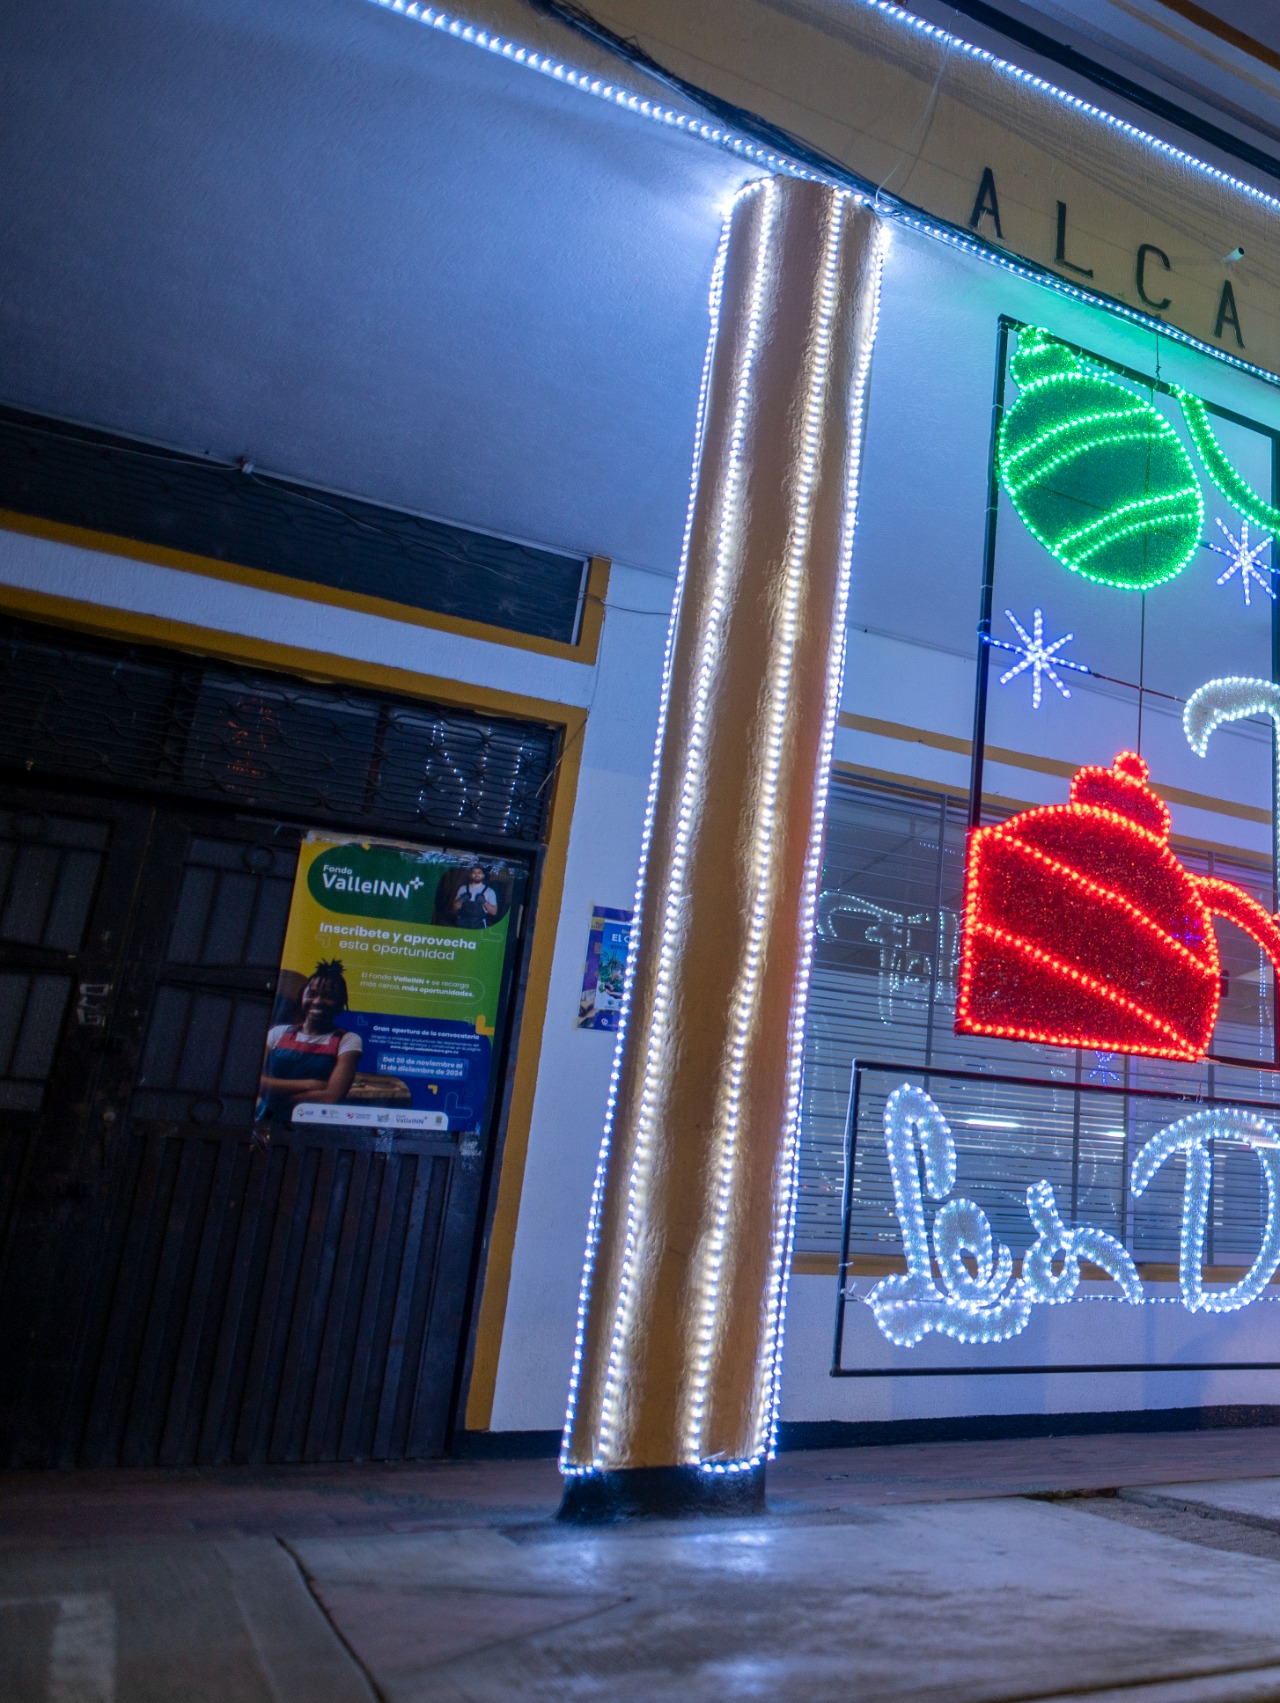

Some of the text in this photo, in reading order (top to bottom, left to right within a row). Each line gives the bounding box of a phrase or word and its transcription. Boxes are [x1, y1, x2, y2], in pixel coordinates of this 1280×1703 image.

[323, 864, 353, 875] Fondo
[319, 922, 477, 950] Inscribete y aprovecha
[339, 939, 455, 961] esta oportunidad
[369, 973, 391, 981] Fondo
[416, 1059, 455, 1069] noviembre
[397, 1065, 435, 1075] diciembre
